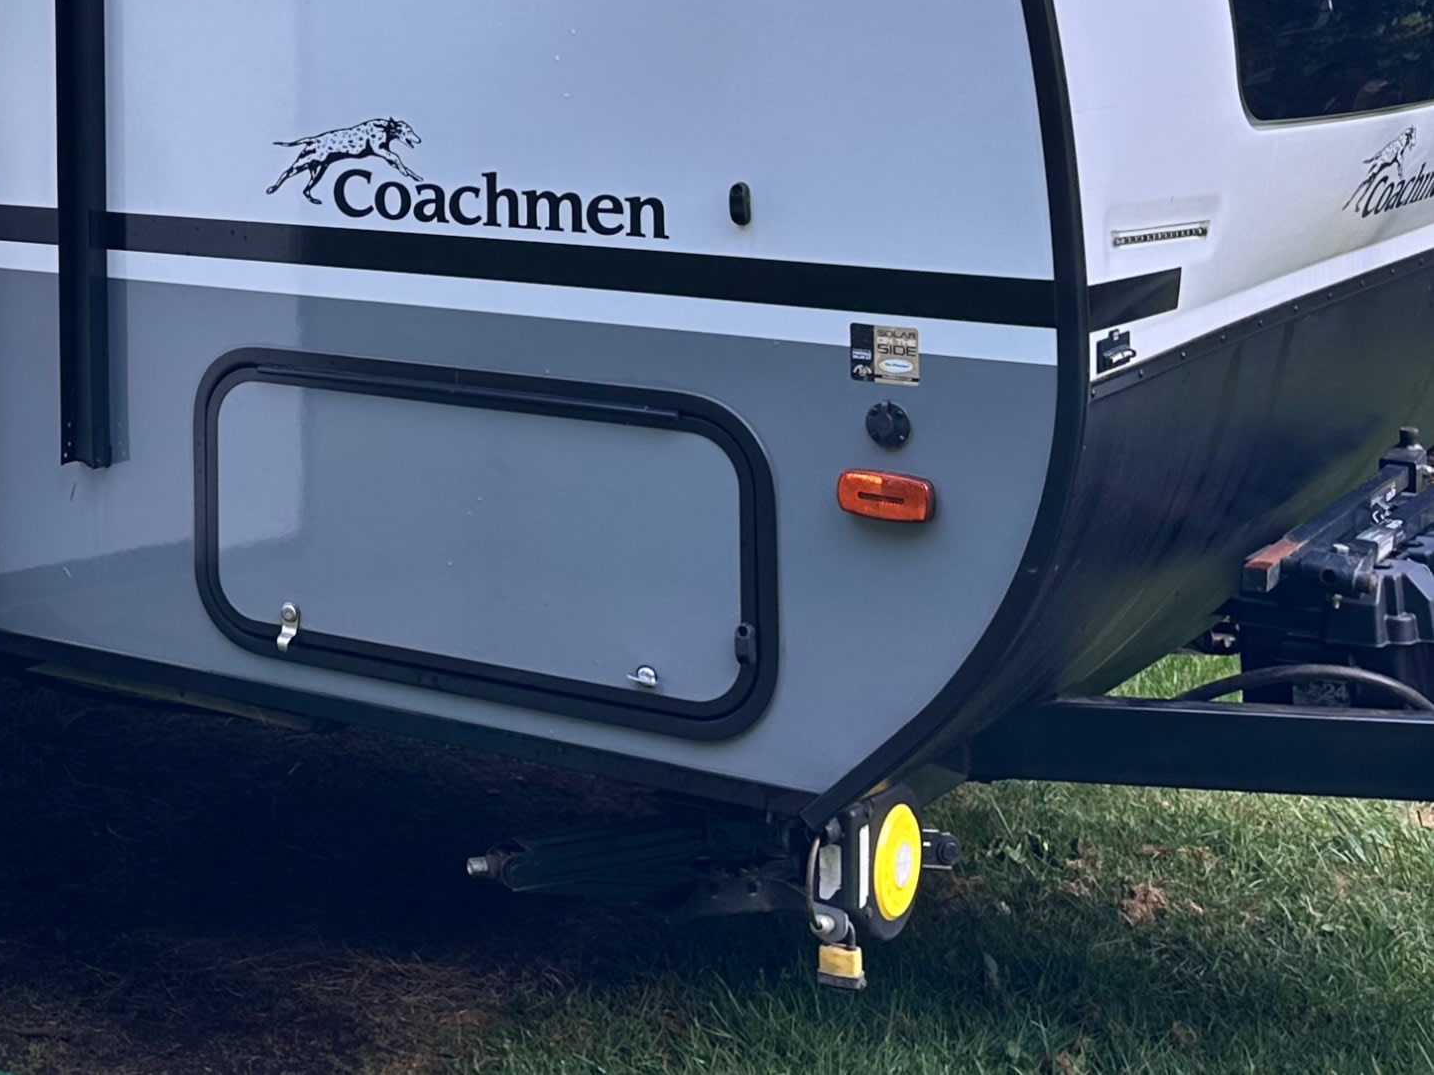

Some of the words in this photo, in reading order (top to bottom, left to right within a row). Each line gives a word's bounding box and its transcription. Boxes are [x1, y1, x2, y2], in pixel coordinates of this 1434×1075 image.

[333, 169, 670, 240] Coachmen
[1362, 162, 1434, 218] Coachm
[877, 329, 916, 340] SOLAR
[877, 344, 917, 357] SIDE
